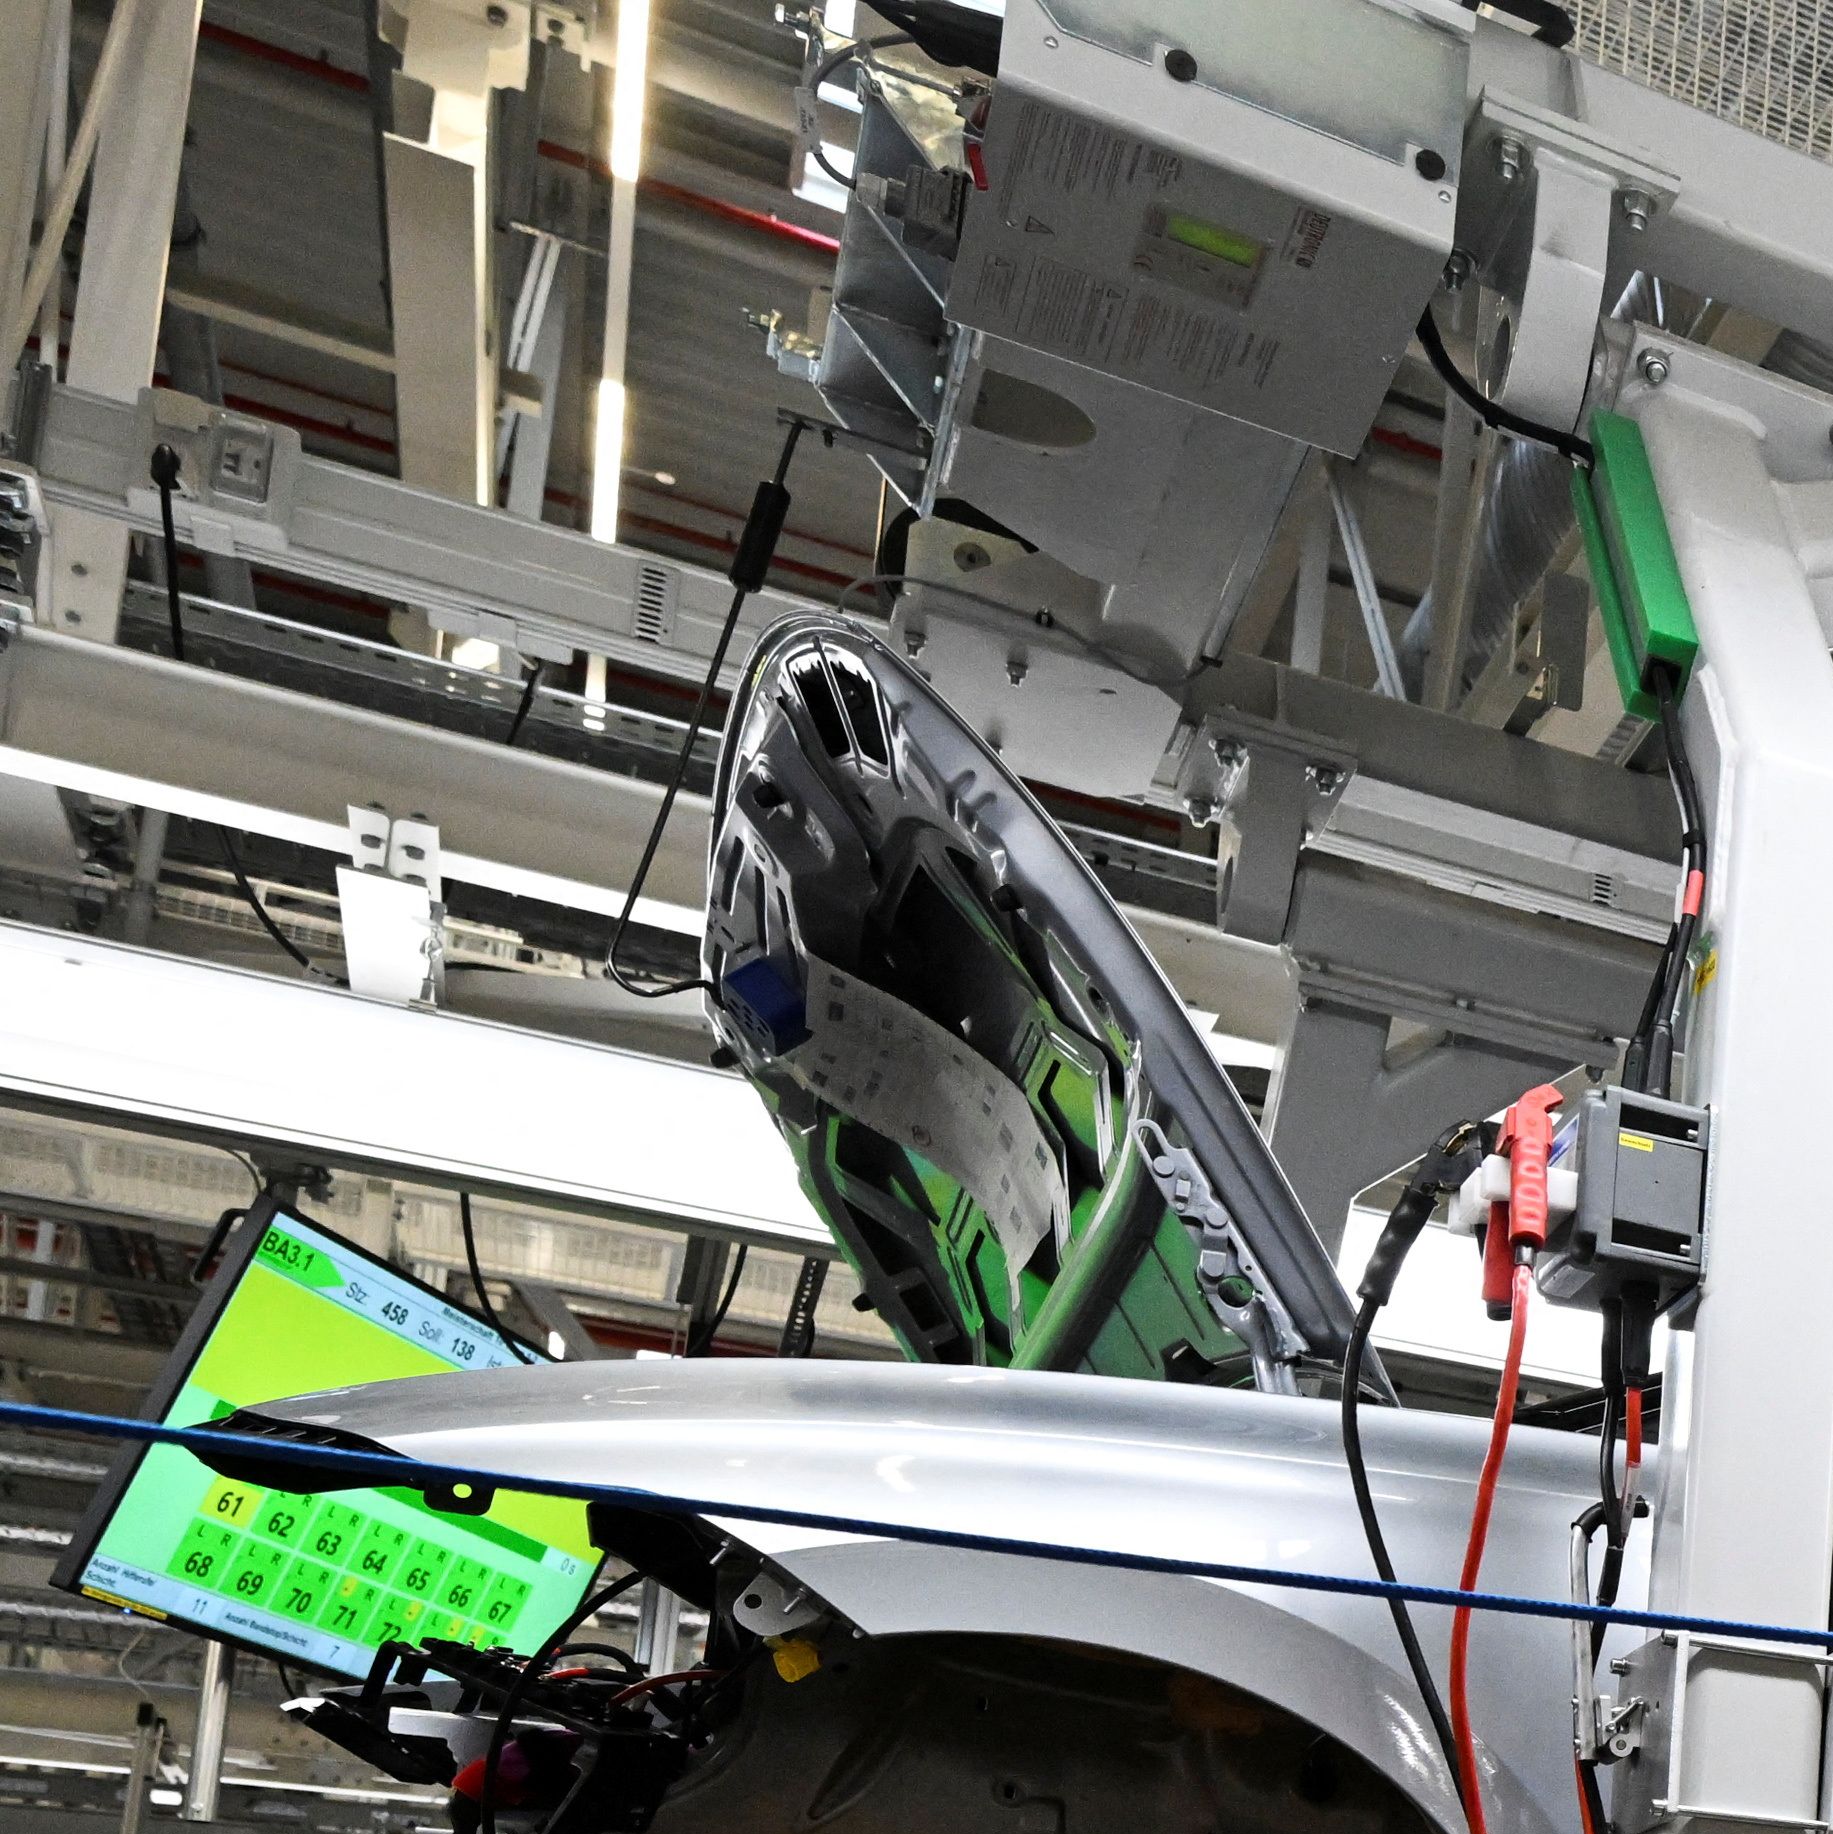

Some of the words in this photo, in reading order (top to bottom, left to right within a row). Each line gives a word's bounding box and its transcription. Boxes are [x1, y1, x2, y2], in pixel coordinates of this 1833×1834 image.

[262, 1230, 316, 1272] BA3.1
[381, 1300, 409, 1326] 458
[452, 1337, 476, 1361] 138
[217, 1491, 244, 1517] 61
[268, 1511, 295, 1538] 62
[328, 1505, 335, 1518] L
[348, 1514, 359, 1527] R
[197, 1524, 205, 1538] L
[220, 1533, 232, 1546] R
[316, 1532, 342, 1556] 63
[374, 1524, 380, 1537] L
[394, 1533, 404, 1546] R
[185, 1551, 214, 1578] 68
[248, 1543, 256, 1557] L
[270, 1553, 282, 1565] R
[362, 1550, 388, 1574] 64
[417, 1543, 424, 1556] L
[437, 1551, 446, 1564] R
[297, 1563, 305, 1576] L
[319, 1571, 330, 1584] R
[406, 1568, 431, 1591] 65
[460, 1560, 466, 1573] L
[478, 1567, 487, 1580] R
[236, 1570, 264, 1595] 69
[499, 1579, 506, 1590] L
[516, 1584, 526, 1596] R
[193, 1598, 207, 1614] 11
[285, 1588, 312, 1613] 70
[365, 1589, 375, 1601] R
[389, 1598, 395, 1611] L
[448, 1585, 472, 1608] 66
[333, 1605, 358, 1630] 71
[488, 1601, 512, 1624] 67
[377, 1622, 401, 1642] 72
[329, 1645, 339, 1659] 7
